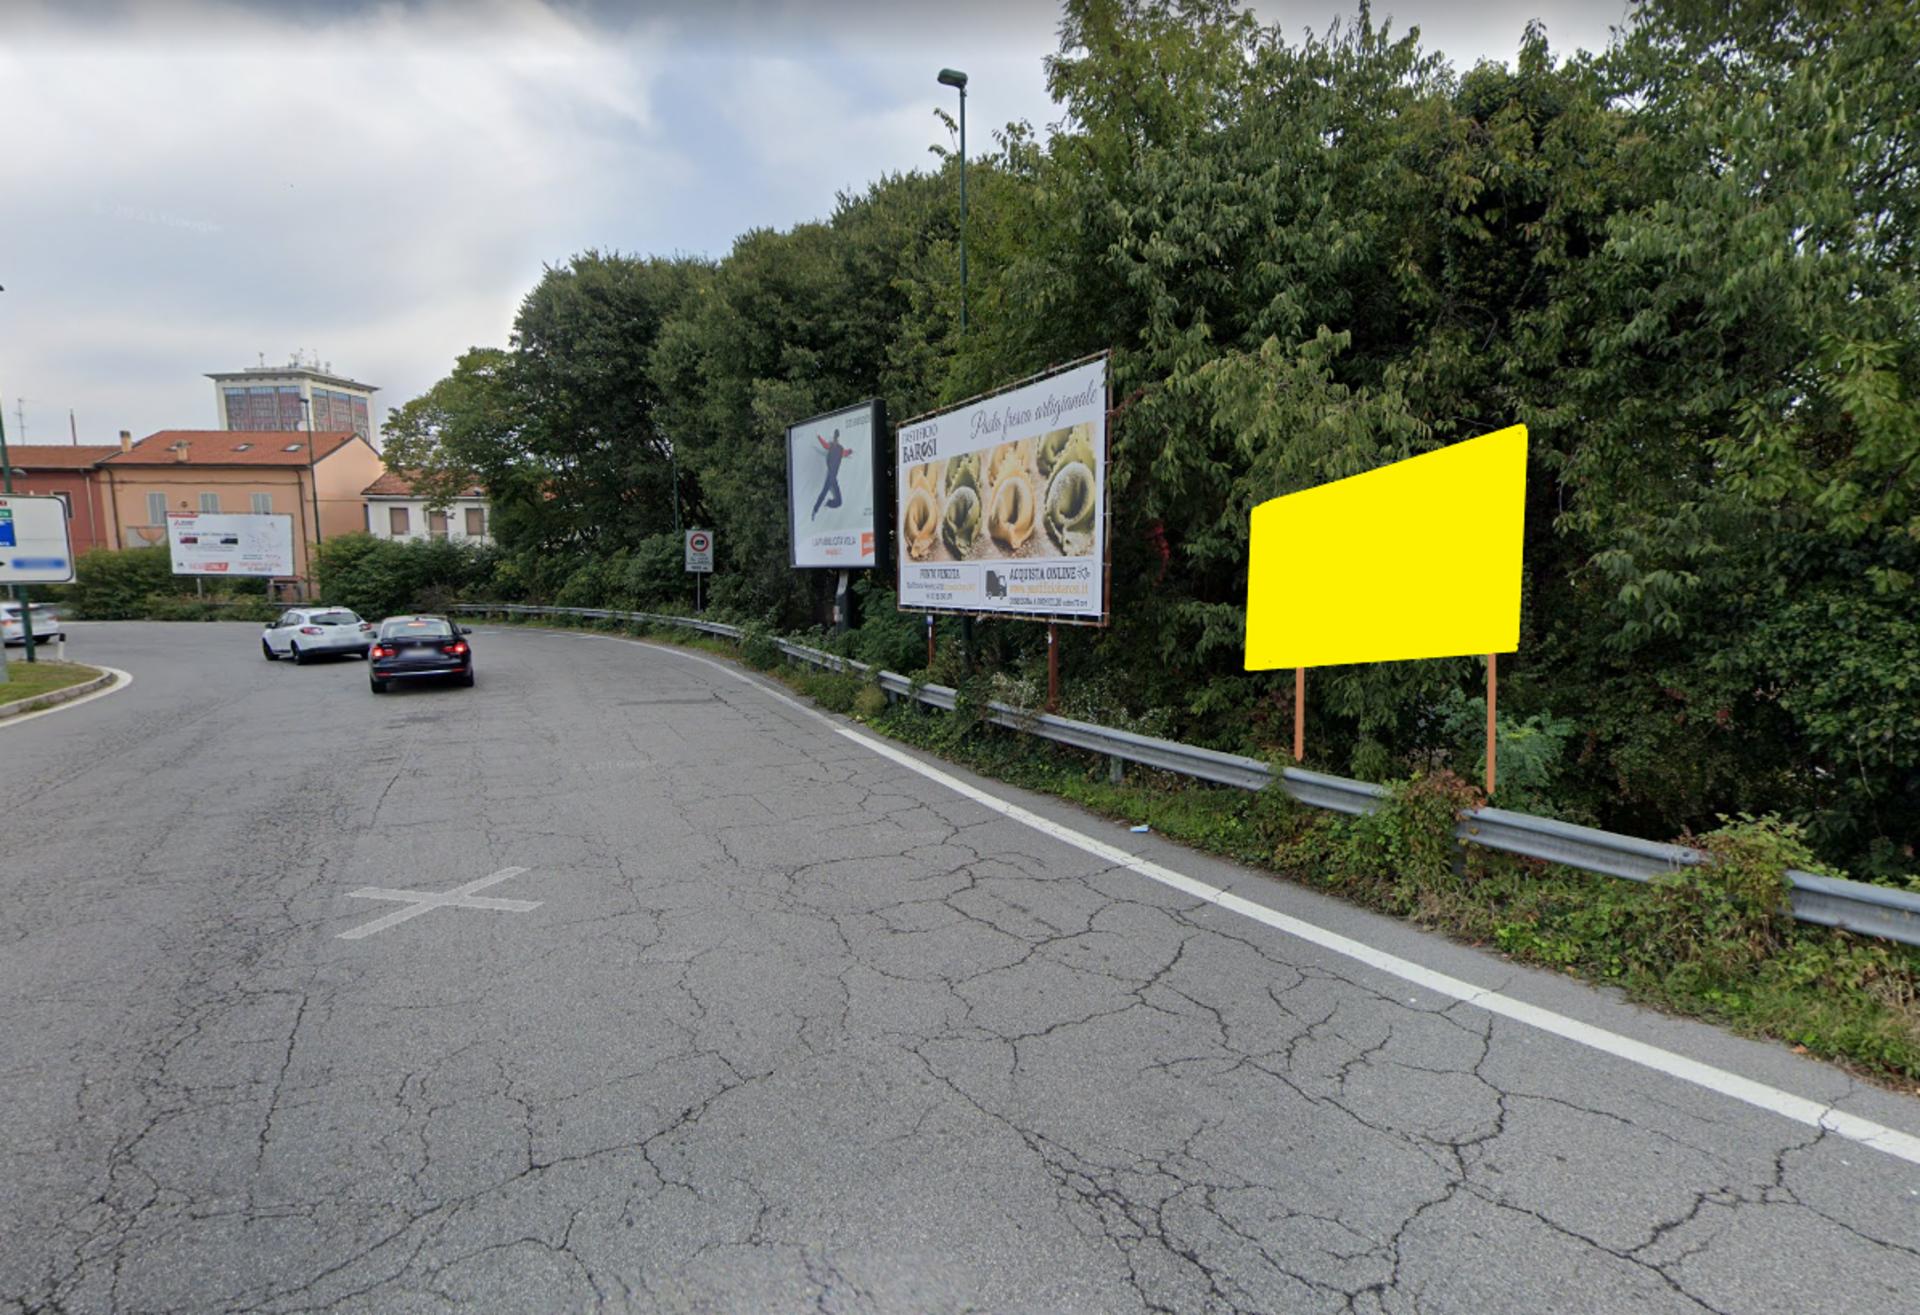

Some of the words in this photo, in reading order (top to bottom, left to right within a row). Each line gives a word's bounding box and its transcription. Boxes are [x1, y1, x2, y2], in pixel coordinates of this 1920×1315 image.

[970, 409, 1000, 439] Pasta
[1034, 379, 1097, 427] artigianale
[902, 438, 937, 463] BAROSI
[1009, 568, 1045, 583] ACQUISTA
[1046, 566, 1076, 580] ONLINE
